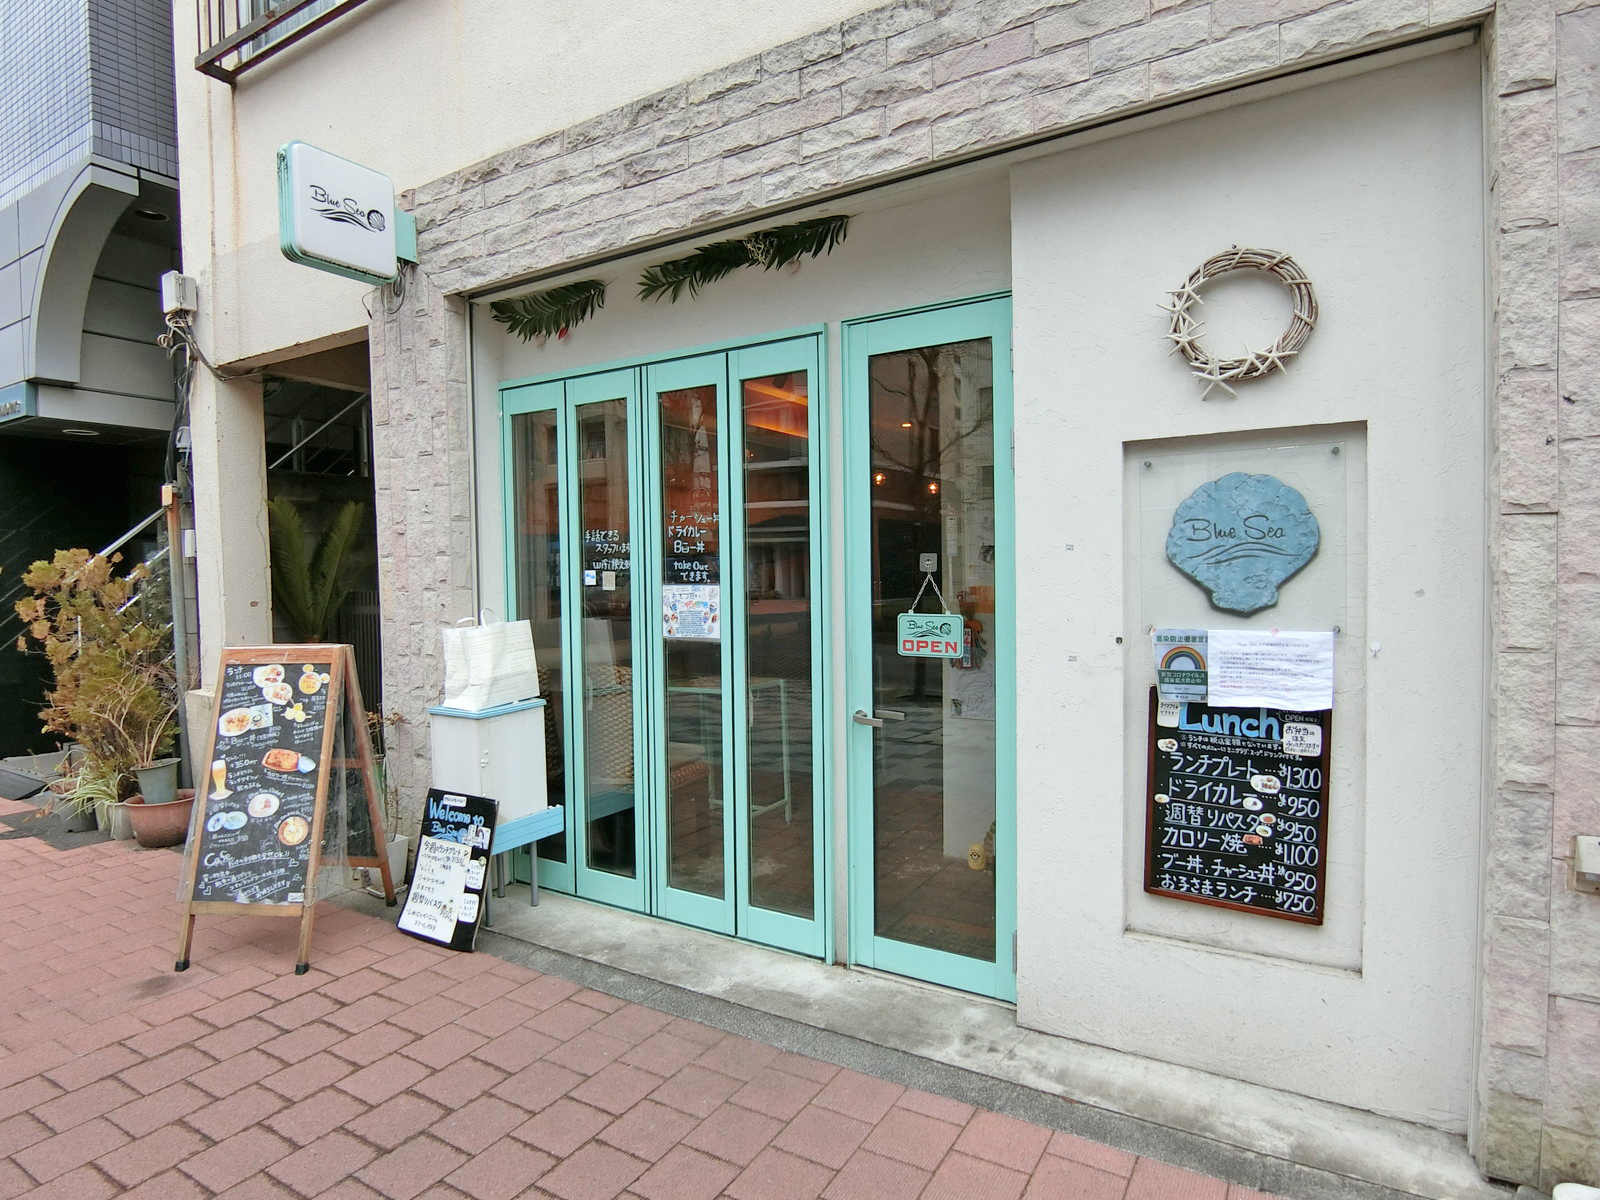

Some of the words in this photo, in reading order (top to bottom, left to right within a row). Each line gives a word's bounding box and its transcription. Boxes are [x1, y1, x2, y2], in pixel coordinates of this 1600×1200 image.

[309, 184, 341, 208] Blue
[343, 198, 367, 218] Sea
[585, 529, 620, 542] 手話できる
[668, 525, 707, 538] ドライカレー
[1183, 518, 1237, 542] Blue
[1243, 514, 1286, 540] Sea
[693, 560, 709, 571] Out
[906, 619, 924, 630] Blue
[925, 620, 938, 631] Sea
[902, 639, 958, 654] OPEN
[1178, 701, 1281, 741] Lunch
[1169, 752, 1260, 780] ランチプレート
[1168, 776, 1258, 806] ドライカレー
[1277, 792, 1320, 818] ¥950
[430, 797, 471, 825] Welcome
[472, 814, 485, 827] to
[1164, 802, 1261, 832] 週替りパスタ
[1277, 818, 1317, 843] ¥950
[1161, 826, 1249, 855] カロリー焼
[1277, 865, 1317, 892] ¥950
[1160, 873, 1257, 904] お子さまランチ
[1275, 889, 1315, 914] ¥750
